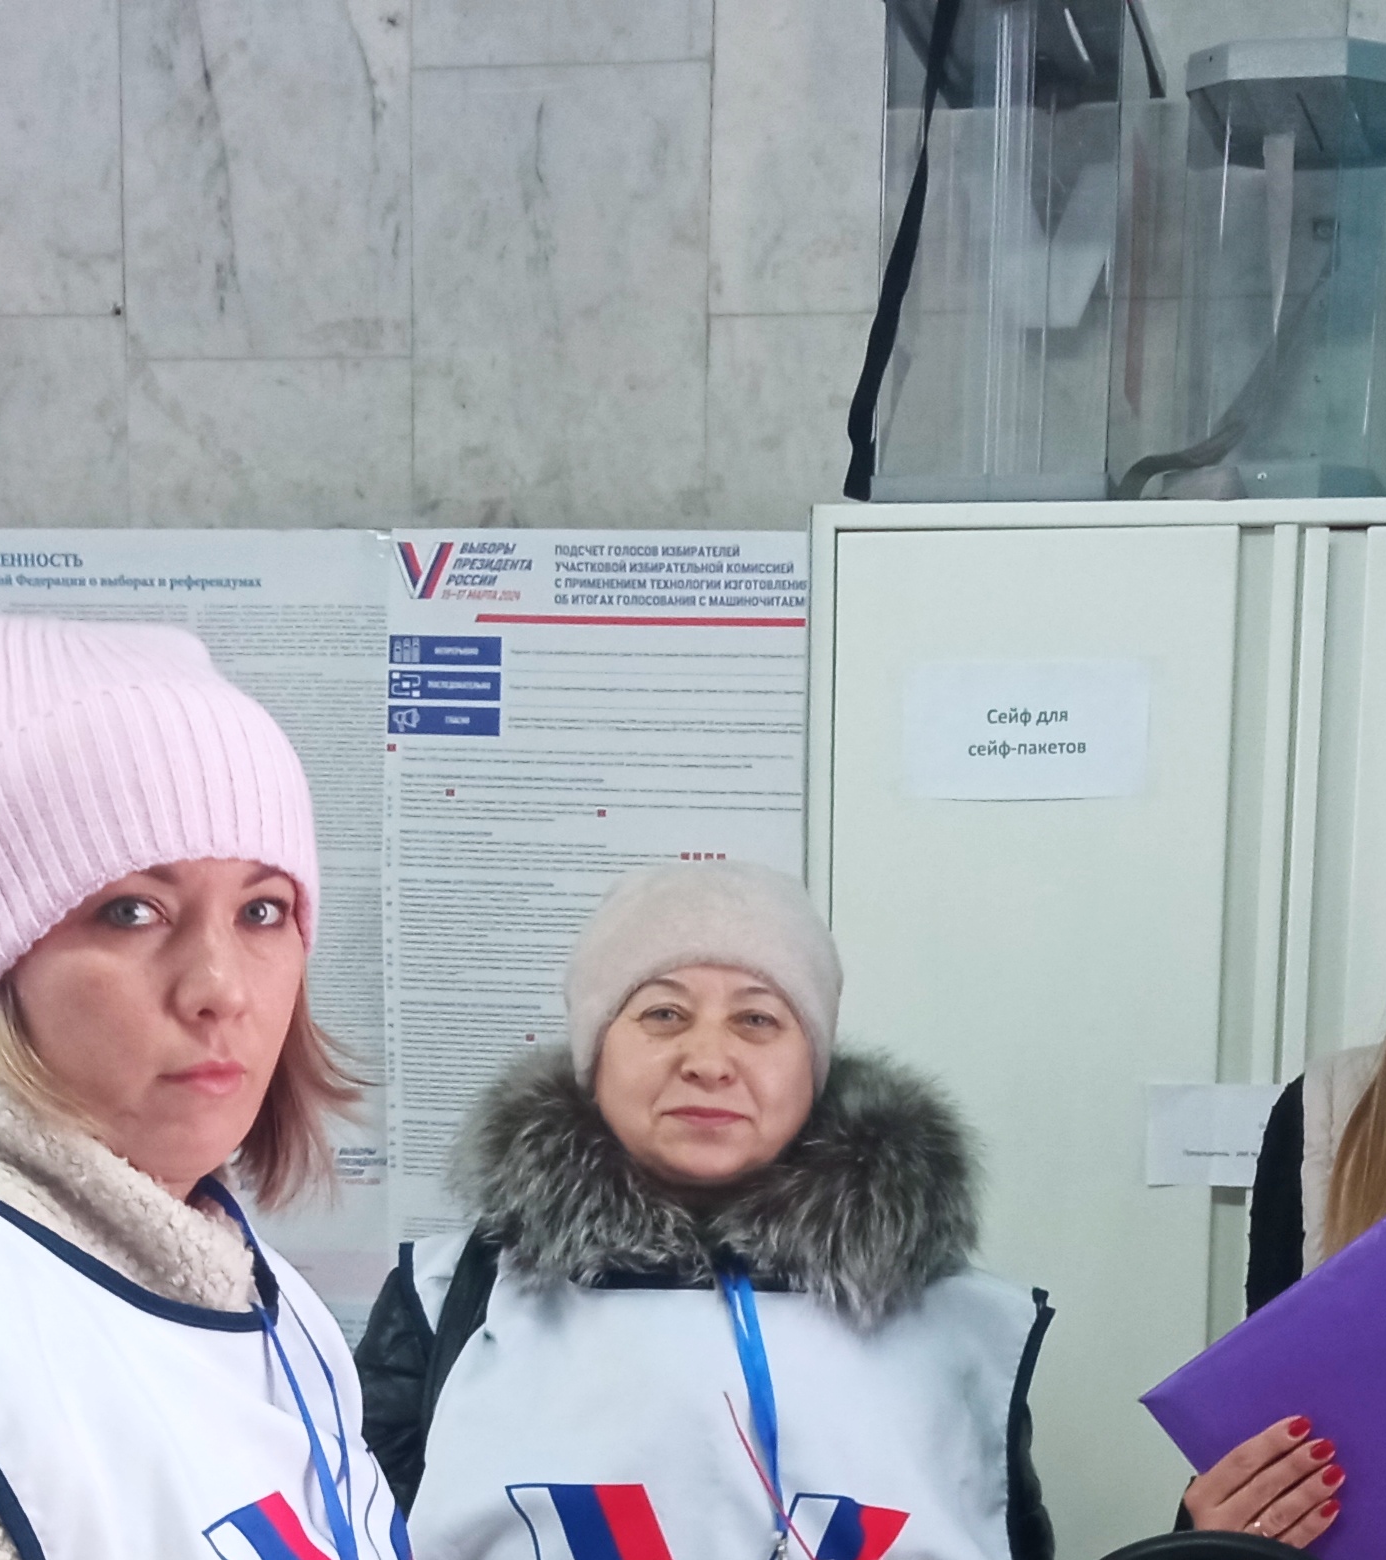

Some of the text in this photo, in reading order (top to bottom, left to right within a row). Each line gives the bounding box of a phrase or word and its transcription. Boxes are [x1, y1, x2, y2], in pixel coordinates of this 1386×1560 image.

[459, 542, 517, 555] ВЫБОРЫ
[554, 544, 741, 558] ПОДСЧЕТ ГОЛОСОВ ИЗБИРАТЕЛЕЙ
[452, 558, 533, 572] ПРЕЗИДЕНТА
[554, 561, 794, 574] УЧАСТКОВОЙ ИЗБИРАТЕЛЬНОЙ КОМИССИЕЙ
[16, 574, 86, 589] Федерации
[100, 575, 155, 590] выборах
[169, 575, 261, 591] референдумах
[445, 575, 498, 586] РОССИИ
[565, 578, 647, 590] ПРИМЕНЕНИЕМ
[650, 579, 723, 590] ТЕХНОЛОГИИ
[554, 595, 569, 605] ОБ
[572, 595, 614, 605] ИТОГАХ
[617, 595, 696, 606] ГОЛОСОВАНИЯ
[986, 707, 1069, 727] Сейф для
[968, 740, 1087, 759] сейф-пакетов
